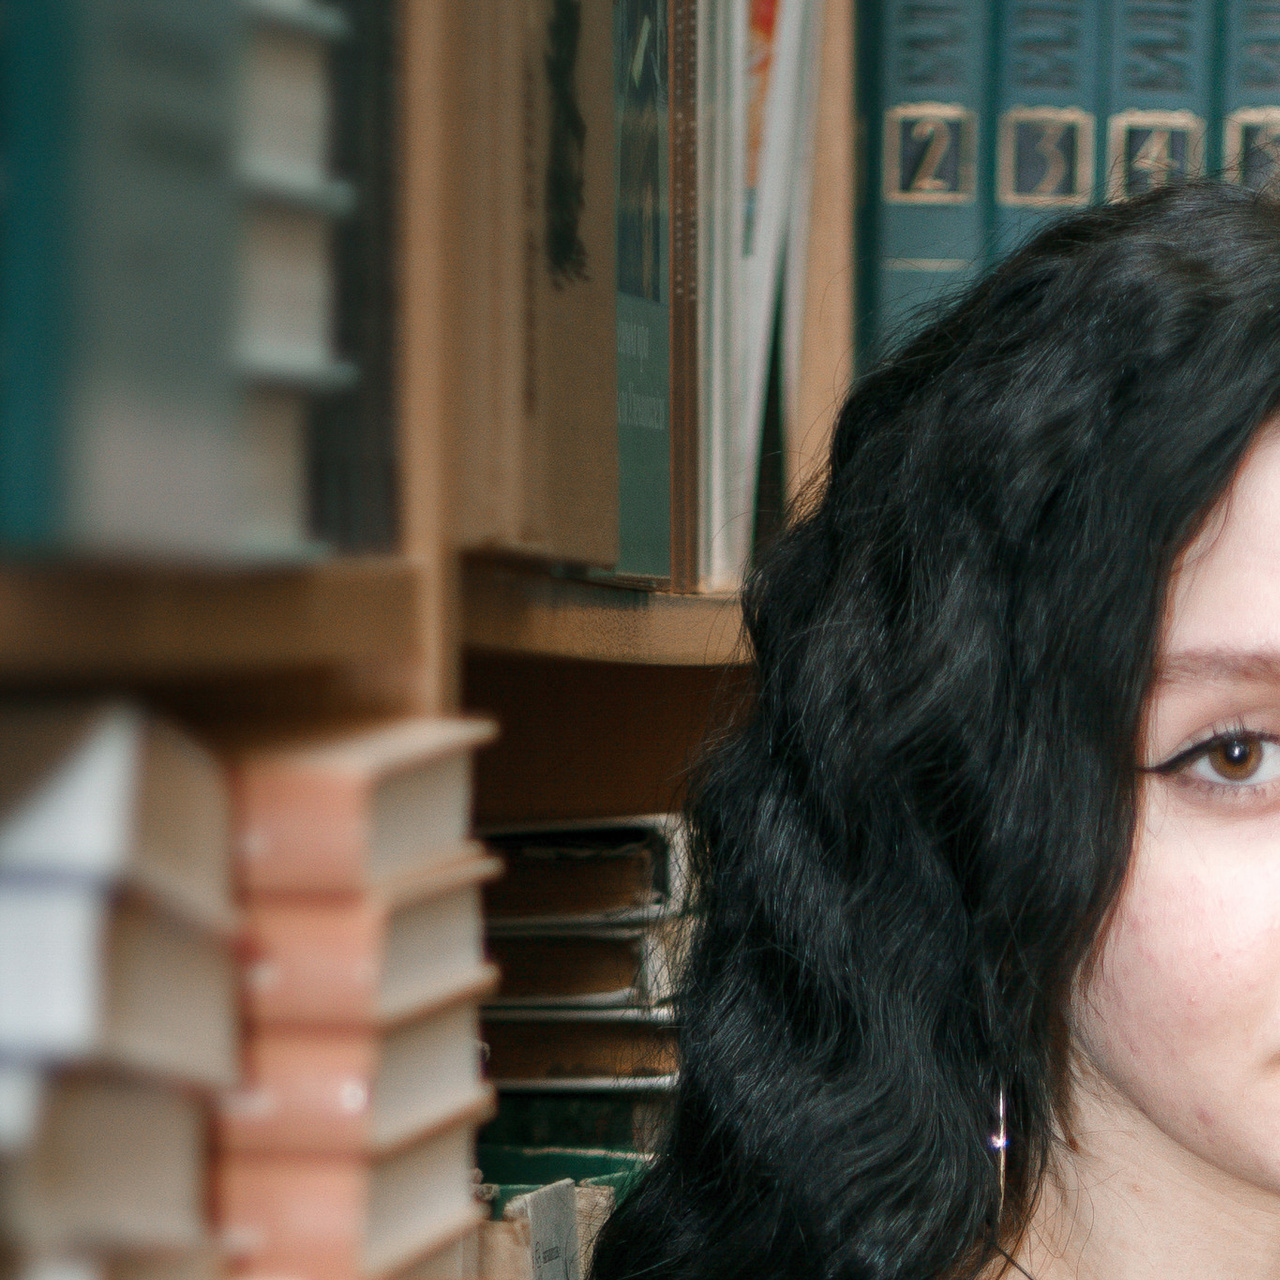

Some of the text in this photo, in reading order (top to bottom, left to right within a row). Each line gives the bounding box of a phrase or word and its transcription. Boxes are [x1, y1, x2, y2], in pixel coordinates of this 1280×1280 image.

[911, 120, 949, 191] 2
[1033, 123, 1067, 193] 3
[1131, 130, 1178, 188] 4
